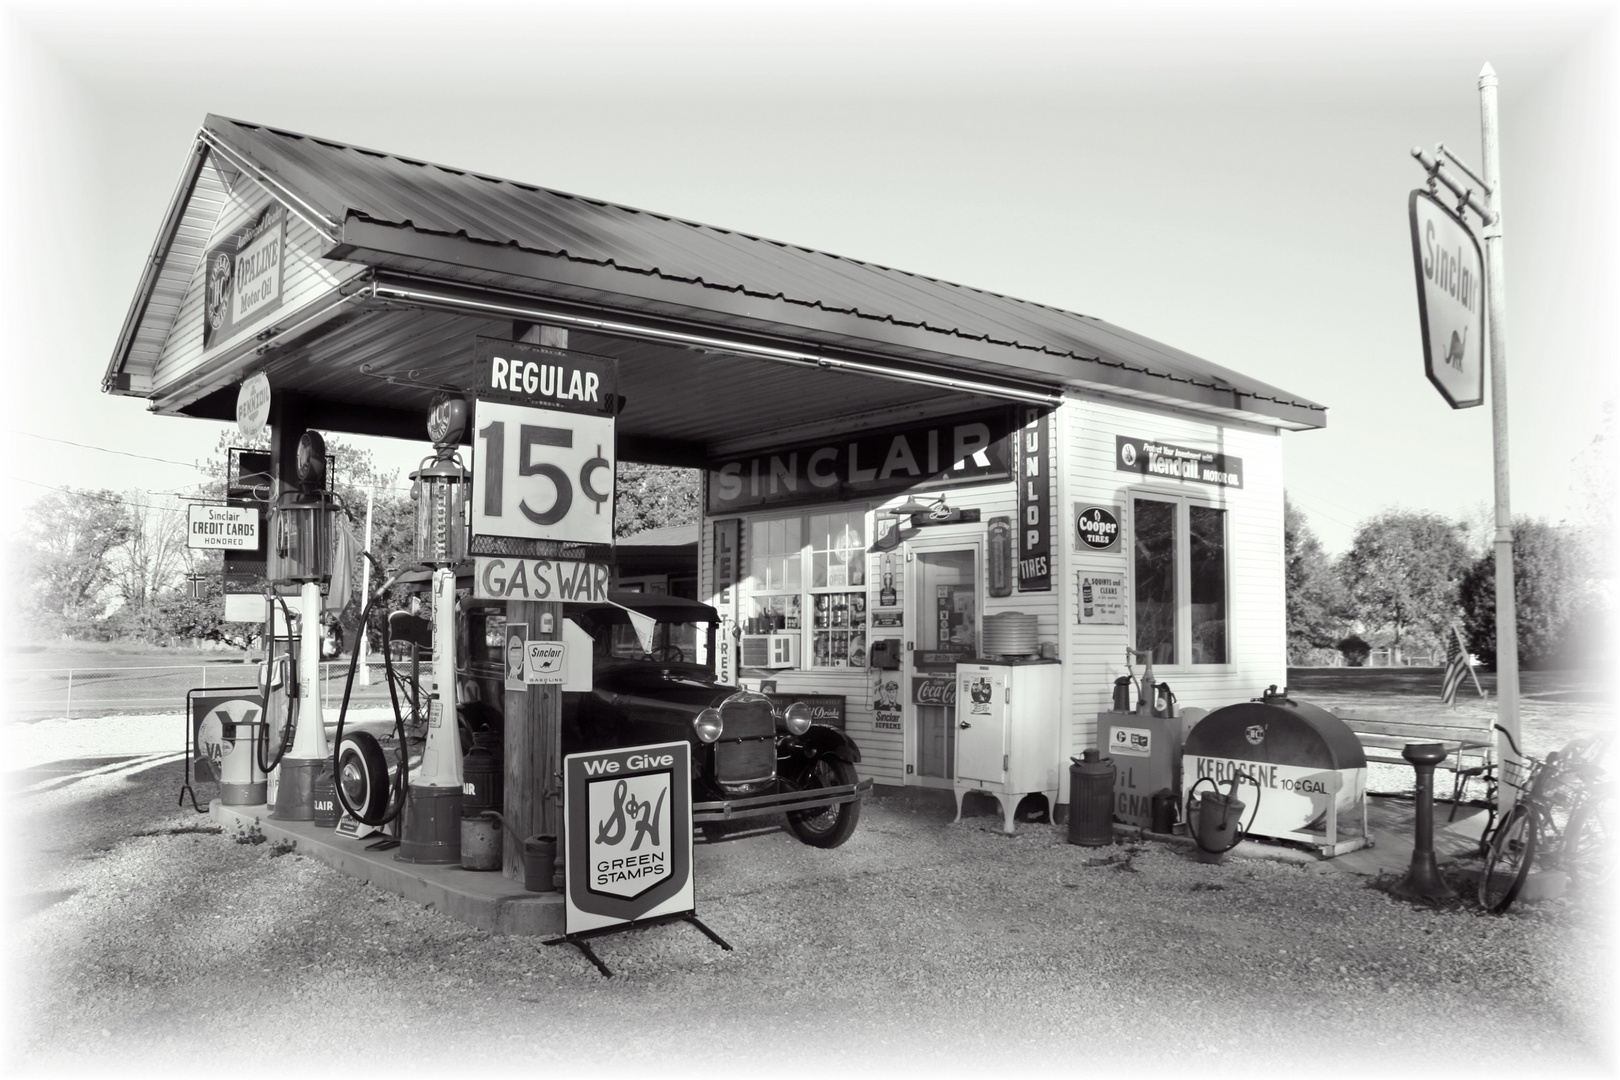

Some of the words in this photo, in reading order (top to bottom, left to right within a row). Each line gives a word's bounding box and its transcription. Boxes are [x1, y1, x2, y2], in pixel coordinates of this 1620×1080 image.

[237, 238, 279, 295] OPALINE
[1424, 219, 1478, 315] Sinclair
[240, 287, 261, 314] Motor
[261, 276, 272, 300] Oil
[491, 356, 599, 402] REGULAR
[238, 386, 270, 421] PENNZOIL
[718, 422, 991, 501] SINCLAIR
[1148, 452, 1199, 479] Kendall
[1026, 408, 1040, 551] DUNLOP
[1202, 469, 1227, 484] MOTOR
[1227, 473, 1240, 486] OIL
[208, 509, 240, 522] Sinclair
[1079, 516, 1117, 535] Cooper
[193, 521, 223, 536] CREDIT
[226, 522, 255, 537] CARDS
[1087, 534, 1110, 544] TIRES
[204, 537, 244, 546] HONORED
[482, 558, 552, 599] GAS
[556, 561, 609, 601] WAR
[719, 532, 731, 605] LEE
[1020, 556, 1048, 580] TIRES
[531, 647, 562, 657] Sinclair
[720, 613, 731, 684] TIRES
[814, 706, 840, 719] Drinks
[876, 711, 900, 722] Sinclair
[875, 722, 901, 730] SUPREME
[583, 759, 621, 776] We
[626, 754, 674, 770] Give
[597, 851, 664, 873] GREEN
[597, 863, 665, 886] STAMPS
